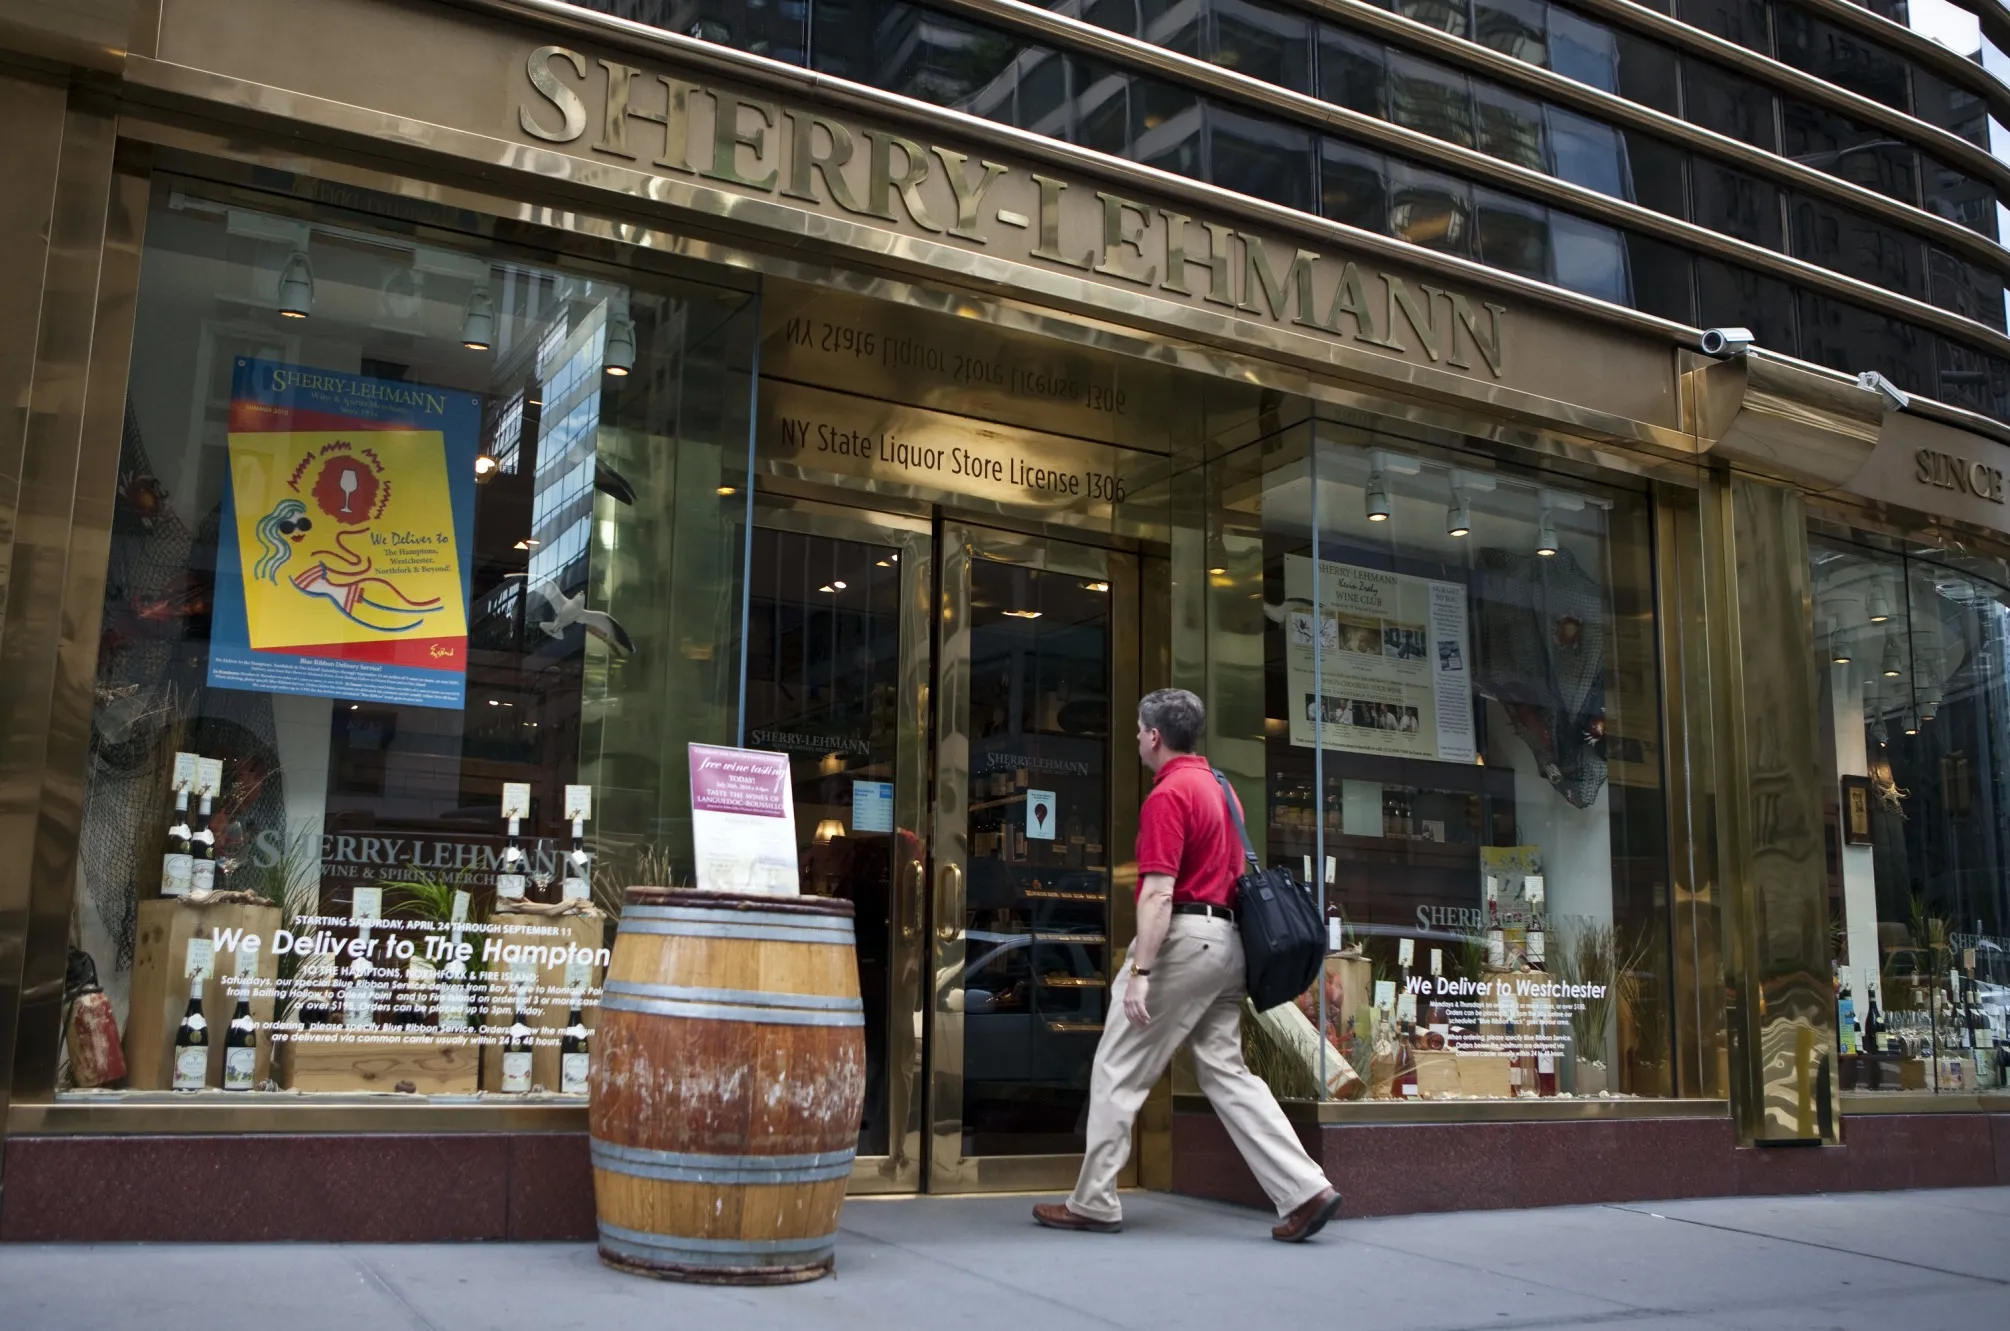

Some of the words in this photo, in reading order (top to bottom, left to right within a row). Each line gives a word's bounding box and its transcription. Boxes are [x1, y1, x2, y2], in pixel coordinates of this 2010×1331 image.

[520, 45, 1507, 378] SHERRY-LEHMANN
[272, 370, 447, 415] SHERRY-LEHMANN
[782, 418, 810, 448] NY
[818, 425, 872, 459] State
[880, 436, 944, 471] Liquor
[951, 448, 1002, 481] Store
[1010, 458, 1078, 495] License
[1086, 472, 1126, 502] 1306
[1915, 447, 2005, 505] SINCE
[371, 532, 387, 545] We
[392, 531, 432, 546] Deliver
[436, 533, 448, 544] to
[384, 548, 397, 556] The
[398, 548, 439, 557] Hamptons,
[390, 557, 435, 565] Westchester,
[375, 567, 411, 575] Northfork
[421, 565, 452, 574] Beyond!
[1336, 591, 1359, 603] WINE
[1360, 595, 1382, 606] CLUB
[314, 659, 335, 667] Ribbon
[336, 662, 359, 671] Delivery
[752, 730, 870, 755] SHERRY-LEHMANN
[697, 756, 722, 772] free
[723, 762, 749, 772] wine
[987, 752, 1088, 776] SHERRY-LEHMANN
[728, 775, 756, 784] TODAY!
[745, 793, 769, 801] WINES
[252, 829, 596, 887] SHERRY-LEHMANN
[319, 864, 359, 878] WINE
[364, 866, 375, 878] &
[379, 867, 437, 883] SPIRITS
[295, 915, 349, 927] STARTING
[349, 917, 405, 930] SATURDAY,
[406, 921, 436, 931] APRIL
[438, 922, 450, 931] 24
[451, 923, 501, 934] THROUGH
[502, 924, 559, 936] SEPTEMBER
[561, 927, 572, 937] 11
[213, 927, 262, 953] We
[271, 929, 380, 959] Deliver
[386, 934, 415, 959] to
[424, 935, 474, 961] The
[302, 966, 317, 974] TO
[321, 966, 338, 975] THE
[341, 967, 403, 978] HAMPTONS,
[405, 969, 467, 980] NORTHFORK
[470, 971, 476, 980] &
[479, 972, 500, 981] FIRE
[221, 976, 273, 987] Saturdays,
[276, 978, 293, 986] our
[294, 978, 330, 989] special
[332, 979, 353, 988] Blue
[356, 980, 389, 989] Ribbon
[392, 981, 428, 991] Service
[429, 982, 466, 992] delivers
[466, 983, 488, 992] from
[489, 985, 507, 995] Bay
[536, 986, 545, 994] to
[1406, 976, 1432, 995] We
[1437, 977, 1492, 996] Deliver
[1497, 979, 1512, 996] to
[1516, 979, 1606, 999] Westchester
[226, 987, 250, 997] from
[252, 988, 287, 999] Baiting
[289, 989, 323, 999] Hollow
[325, 990, 334, 998] to
[397, 992, 415, 1001] and
[417, 993, 427, 1001] to
[429, 993, 445, 1001] Fire
[294, 1001, 304, 1009] or
[307, 1002, 329, 1010] over
[359, 1003, 391, 1011] Orders
[394, 1004, 413, 1012] can
[415, 1005, 428, 1013] be
[466, 1007, 478, 1016] up
[479, 1006, 489, 1014] to
[309, 1022, 340, 1033] please
[340, 1023, 380, 1033] specify
[383, 1023, 403, 1032] Blue
[405, 1024, 438, 1033] Ribbon
[440, 1025, 477, 1034] Service.
[479, 1025, 511, 1034] Orders
[541, 1027, 556, 1035] the
[271, 1033, 289, 1041] are
[291, 1033, 338, 1043] delivered
[340, 1033, 355, 1042] via
[357, 1035, 401, 1043] common
[403, 1035, 434, 1044] carrier
[436, 1035, 468, 1046] usually
[470, 1036, 497, 1045] within
[499, 1036, 510, 1045] 24
[523, 1037, 534, 1045] 48
[535, 1038, 562, 1046] hours.
